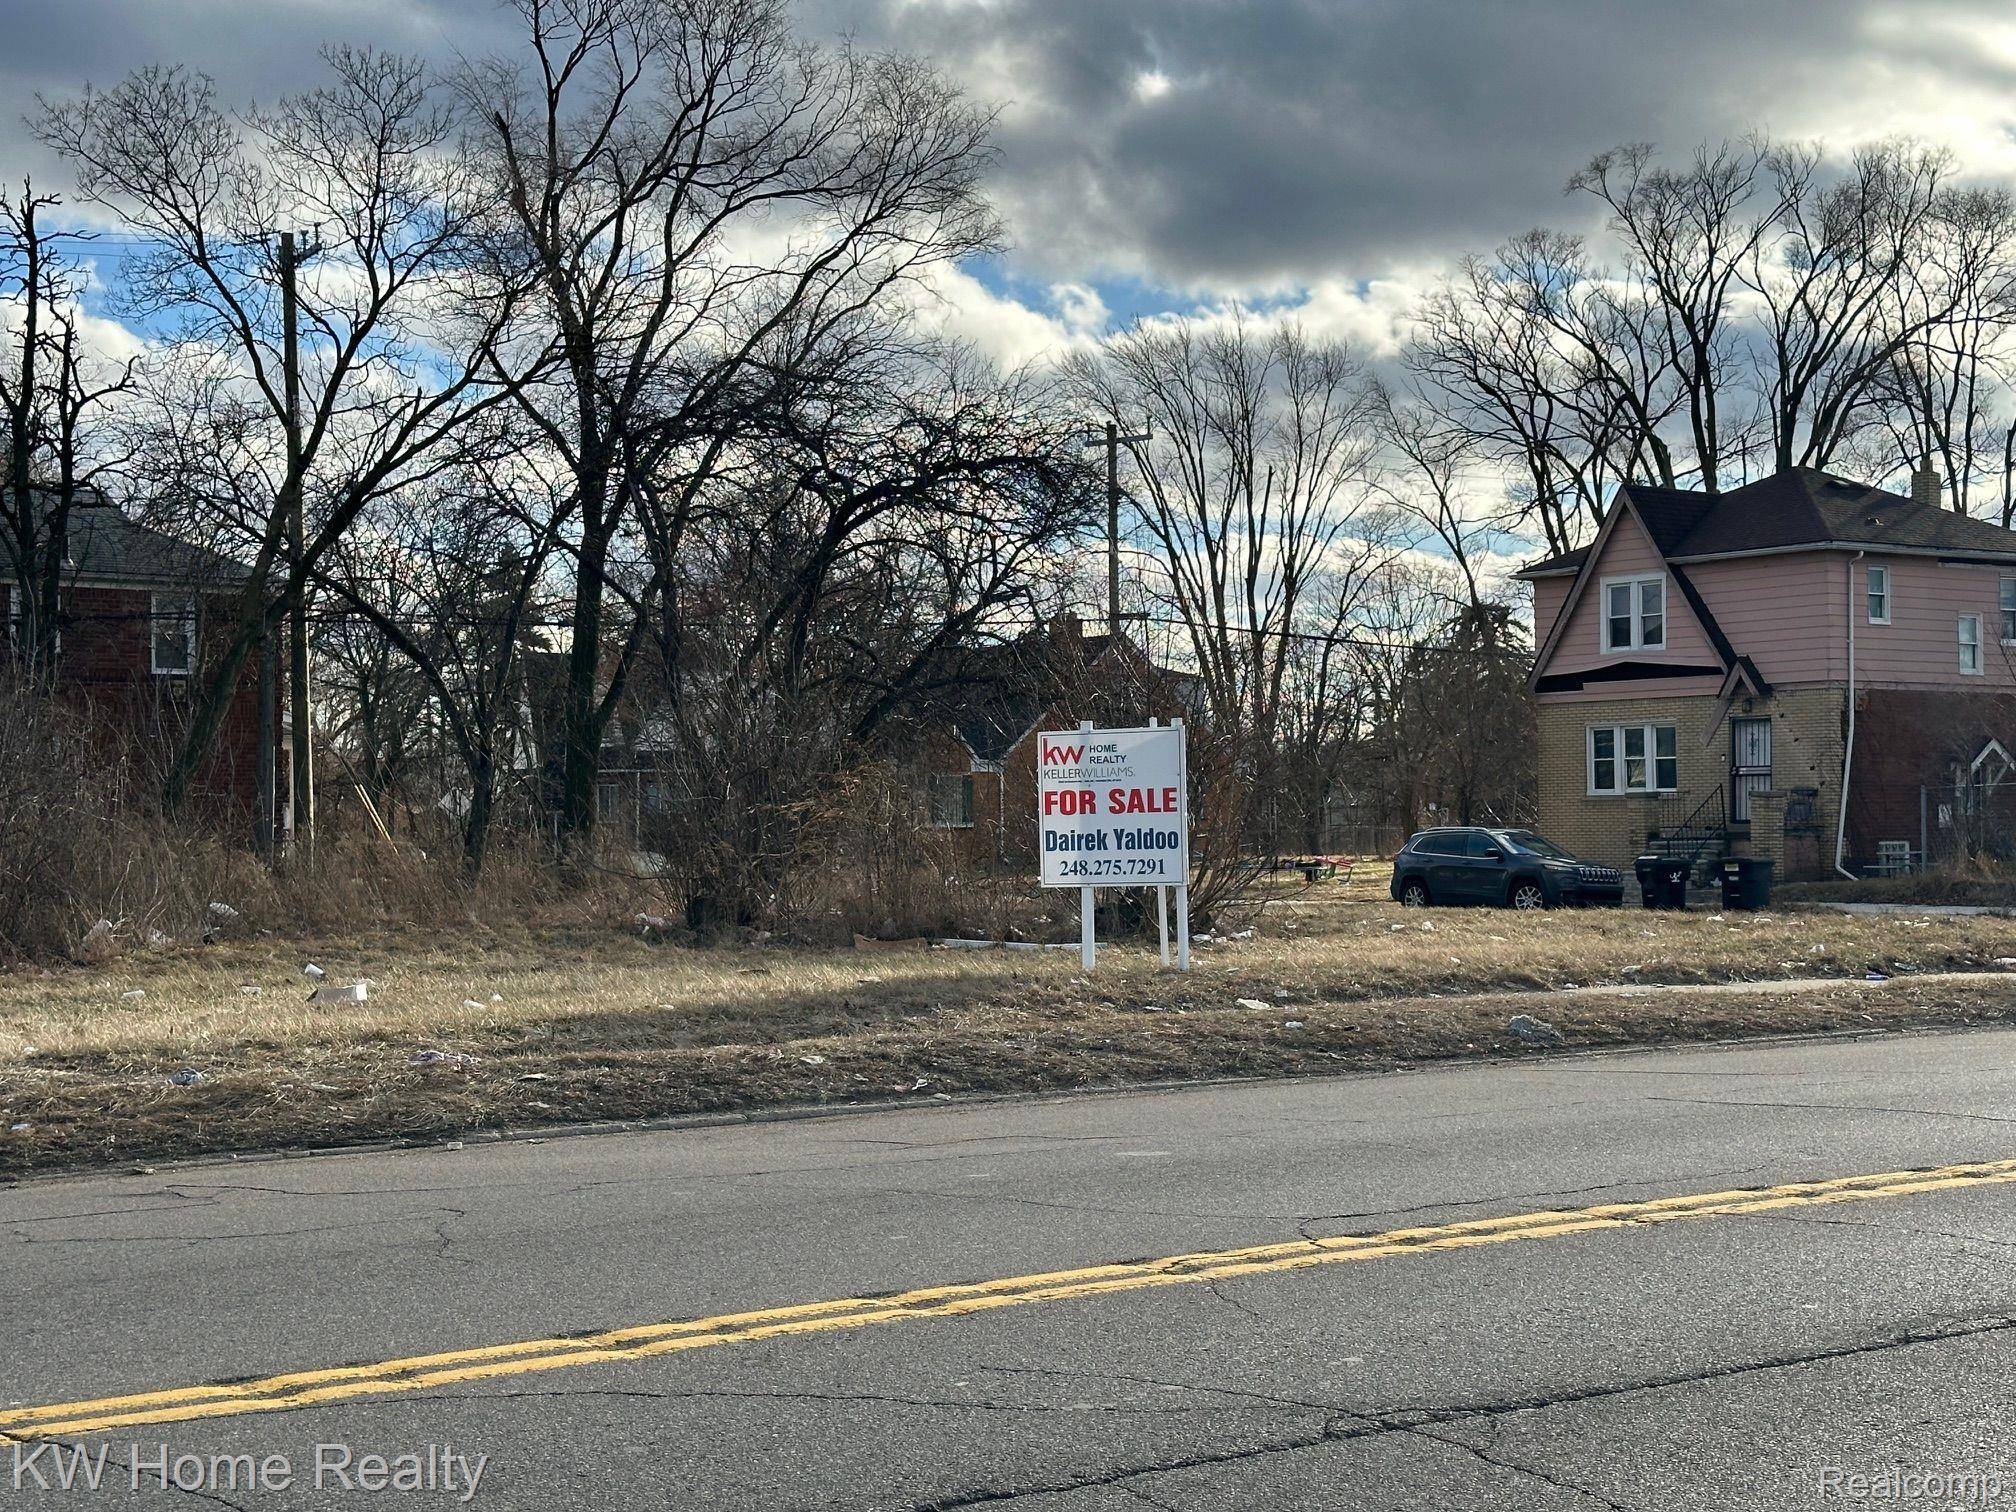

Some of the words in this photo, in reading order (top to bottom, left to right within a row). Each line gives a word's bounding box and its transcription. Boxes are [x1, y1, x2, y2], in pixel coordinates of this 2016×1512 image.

[1089, 744, 1118, 753] HOME
[1089, 755, 1127, 764] REALTY
[1044, 790, 1097, 816] FOR
[1108, 787, 1178, 815] SALE
[1045, 829, 1108, 852] Dairek
[1113, 827, 1179, 851] Yaldoo
[1059, 858, 1166, 876] 248.275.7291
